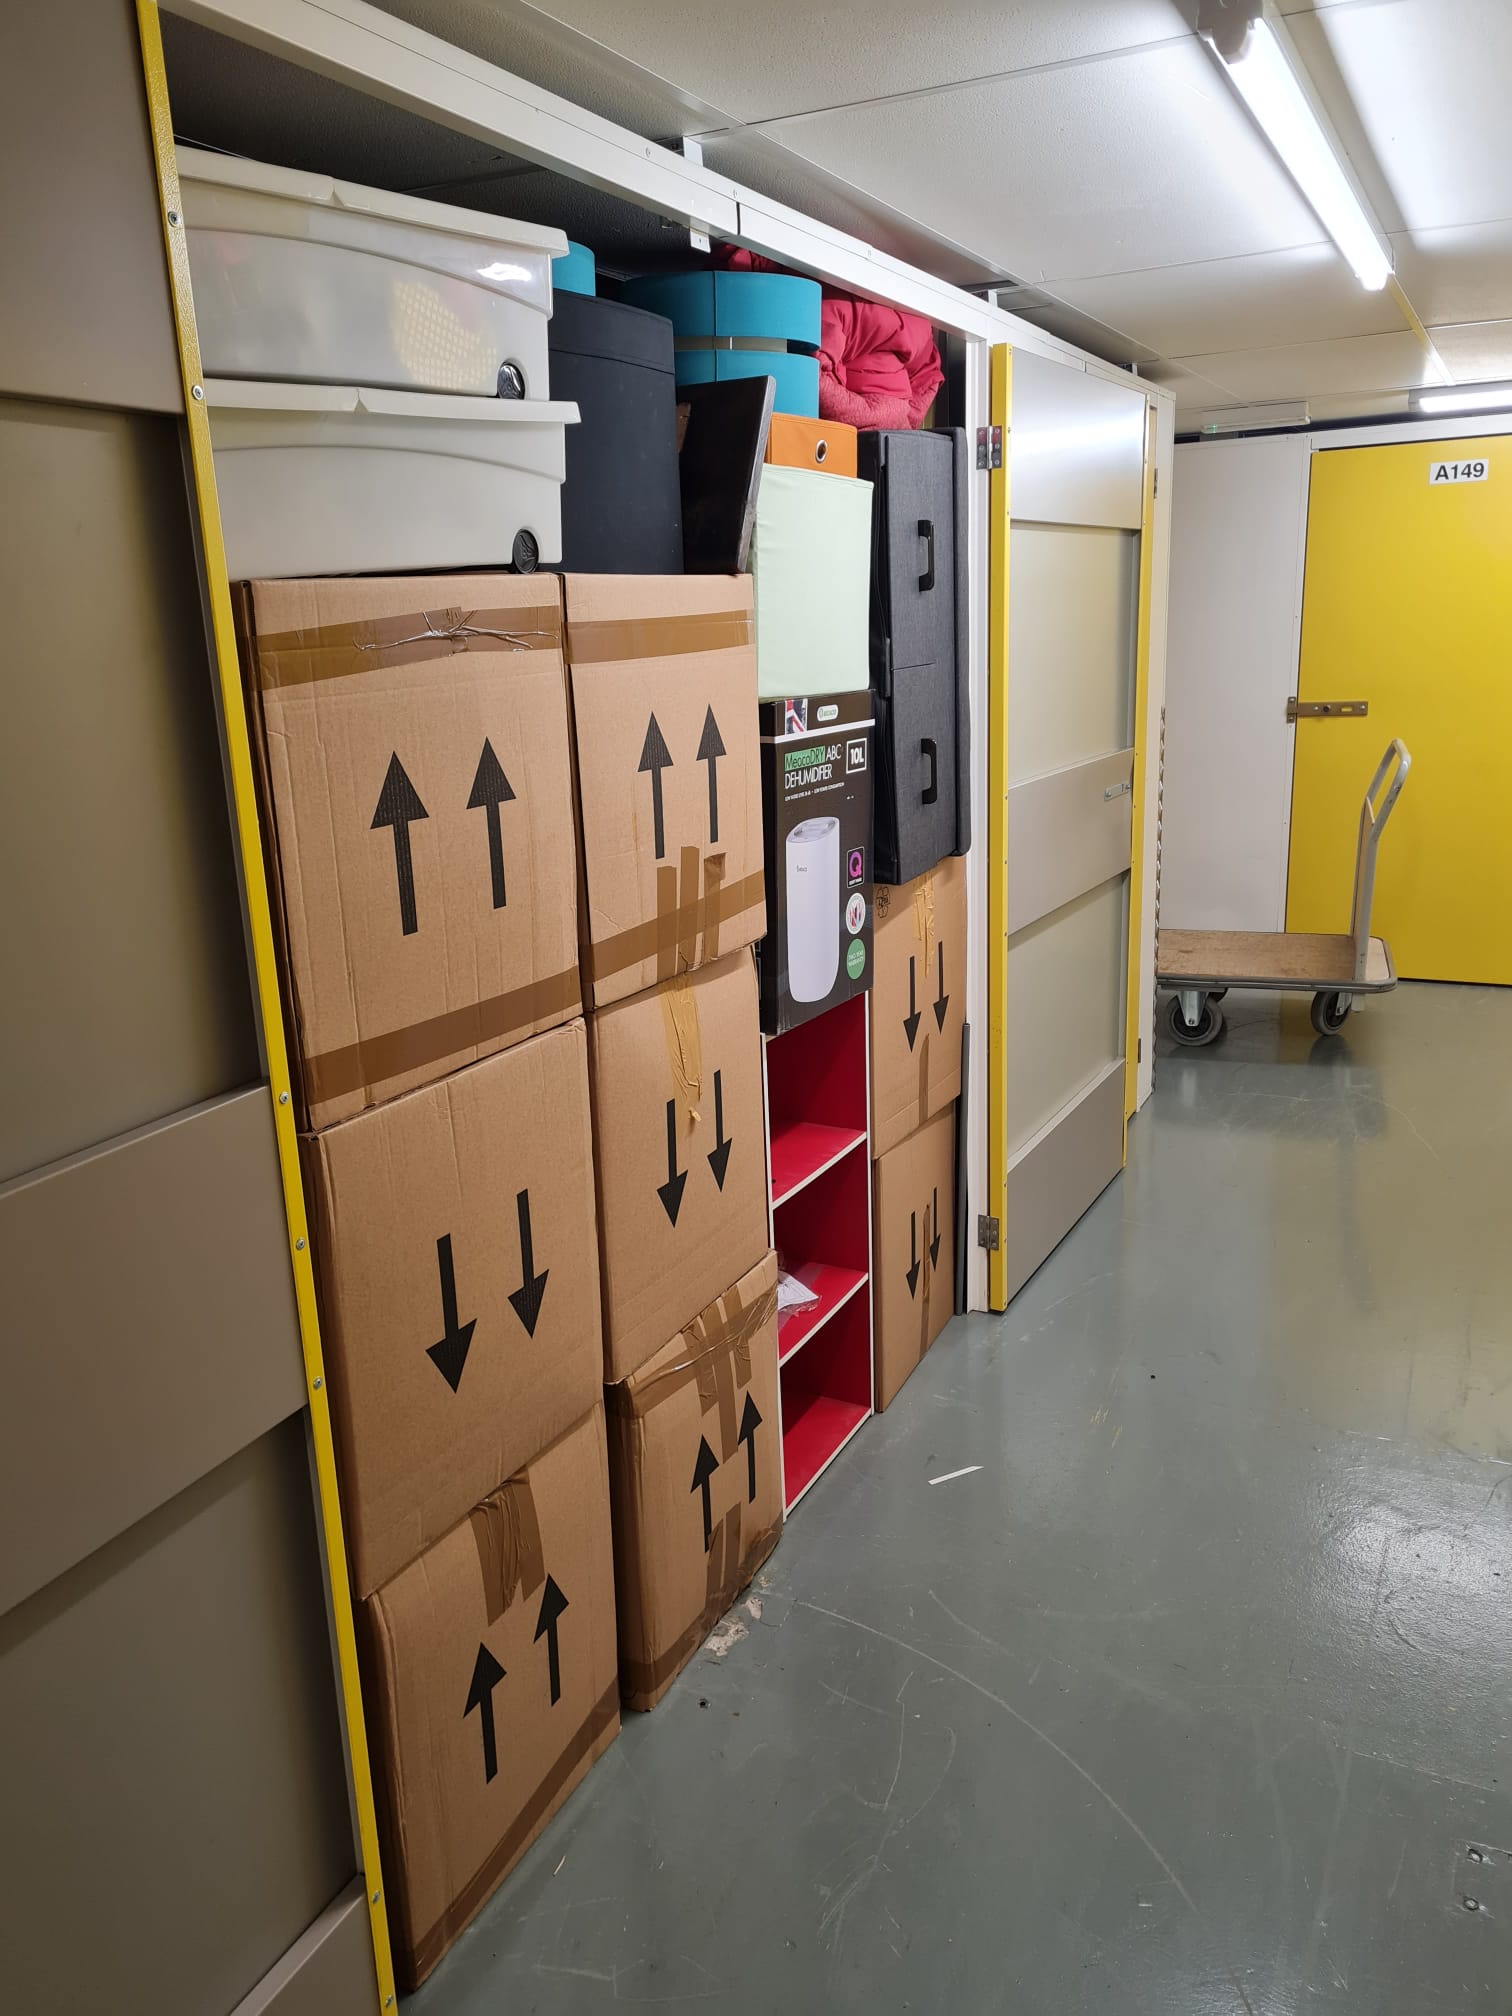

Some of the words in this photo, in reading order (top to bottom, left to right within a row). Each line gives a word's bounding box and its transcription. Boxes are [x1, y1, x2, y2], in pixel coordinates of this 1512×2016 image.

[1434, 462, 1484, 480] A149
[785, 747, 825, 770] MeacoDRY
[826, 743, 842, 762] ABC
[850, 747, 865, 765] 10L
[784, 763, 832, 789] DEHUMIDIFIER
